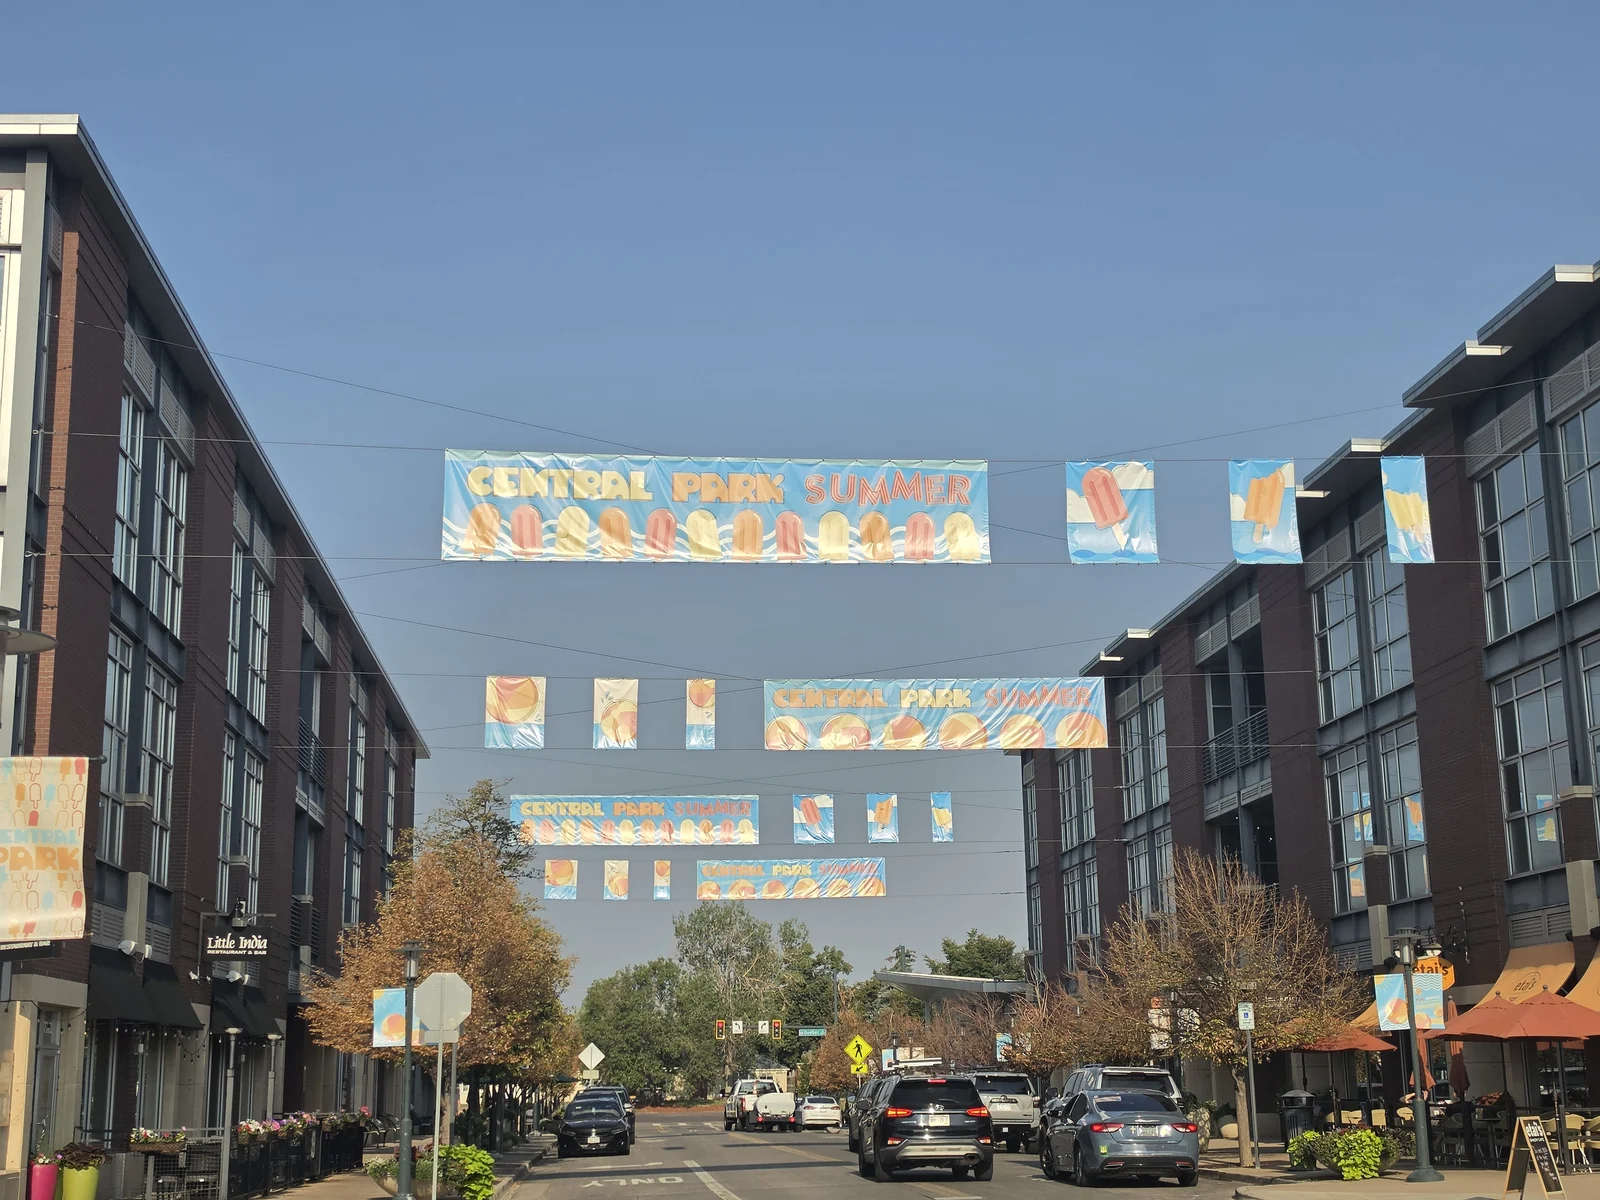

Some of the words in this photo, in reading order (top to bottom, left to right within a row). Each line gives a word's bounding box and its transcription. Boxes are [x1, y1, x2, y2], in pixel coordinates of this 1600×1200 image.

[467, 465, 654, 502] CENTRAL
[672, 471, 785, 504] PARK
[804, 471, 972, 508] SUMMER
[773, 687, 888, 709] CENTRAL
[900, 687, 973, 709] PARK
[984, 686, 1092, 711] SUMMER
[520, 801, 604, 816] CENTRAL
[613, 801, 665, 816] PARK
[673, 799, 751, 817] SUMMER
[0, 829, 80, 844] ENTRAL
[701, 864, 766, 877] CENTRAL
[772, 864, 812, 877] PARK
[0, 942, 34, 951] ESTAURANT
[207, 932, 236, 949] Little
[239, 934, 268, 949] India
[581, 1176, 684, 1188] ONLY
